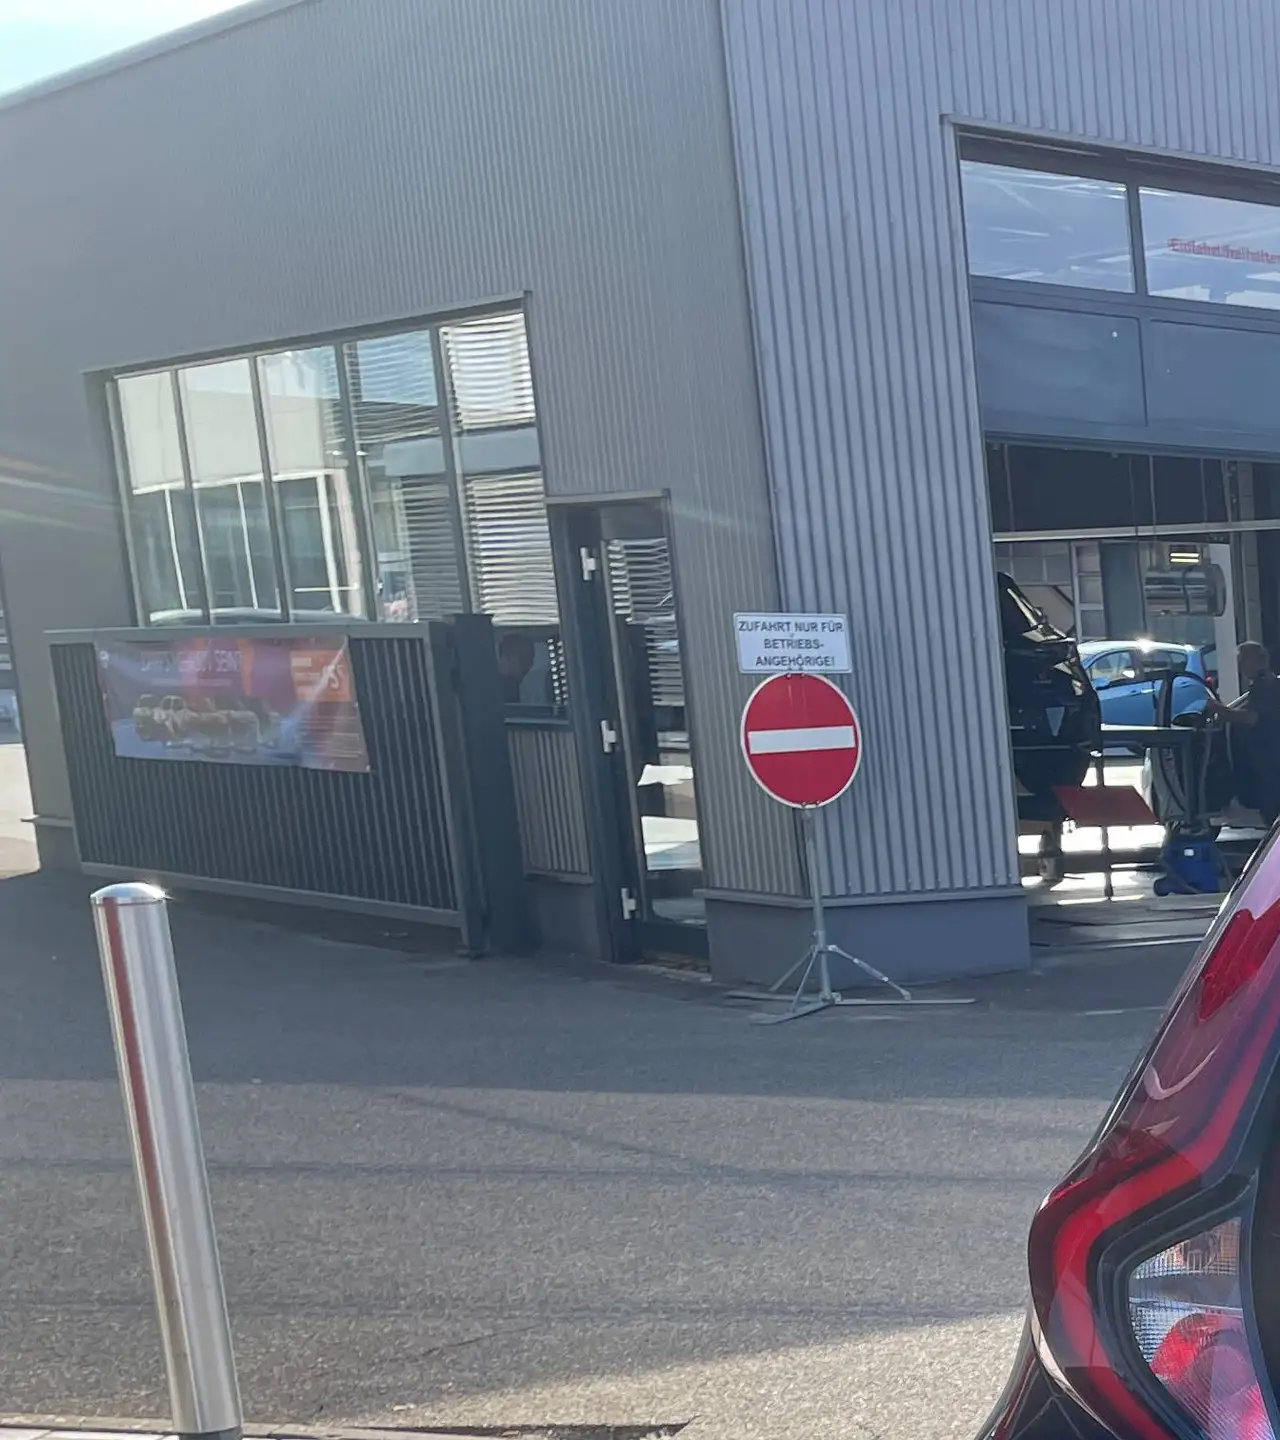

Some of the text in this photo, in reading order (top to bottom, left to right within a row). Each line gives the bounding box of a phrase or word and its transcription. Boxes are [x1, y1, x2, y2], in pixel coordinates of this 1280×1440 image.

[738, 619, 844, 633] ZUFAHRT NUR FÜR
[763, 638, 824, 650] BETRIEBS-
[755, 653, 835, 667] ANGEHÖRIGE!
